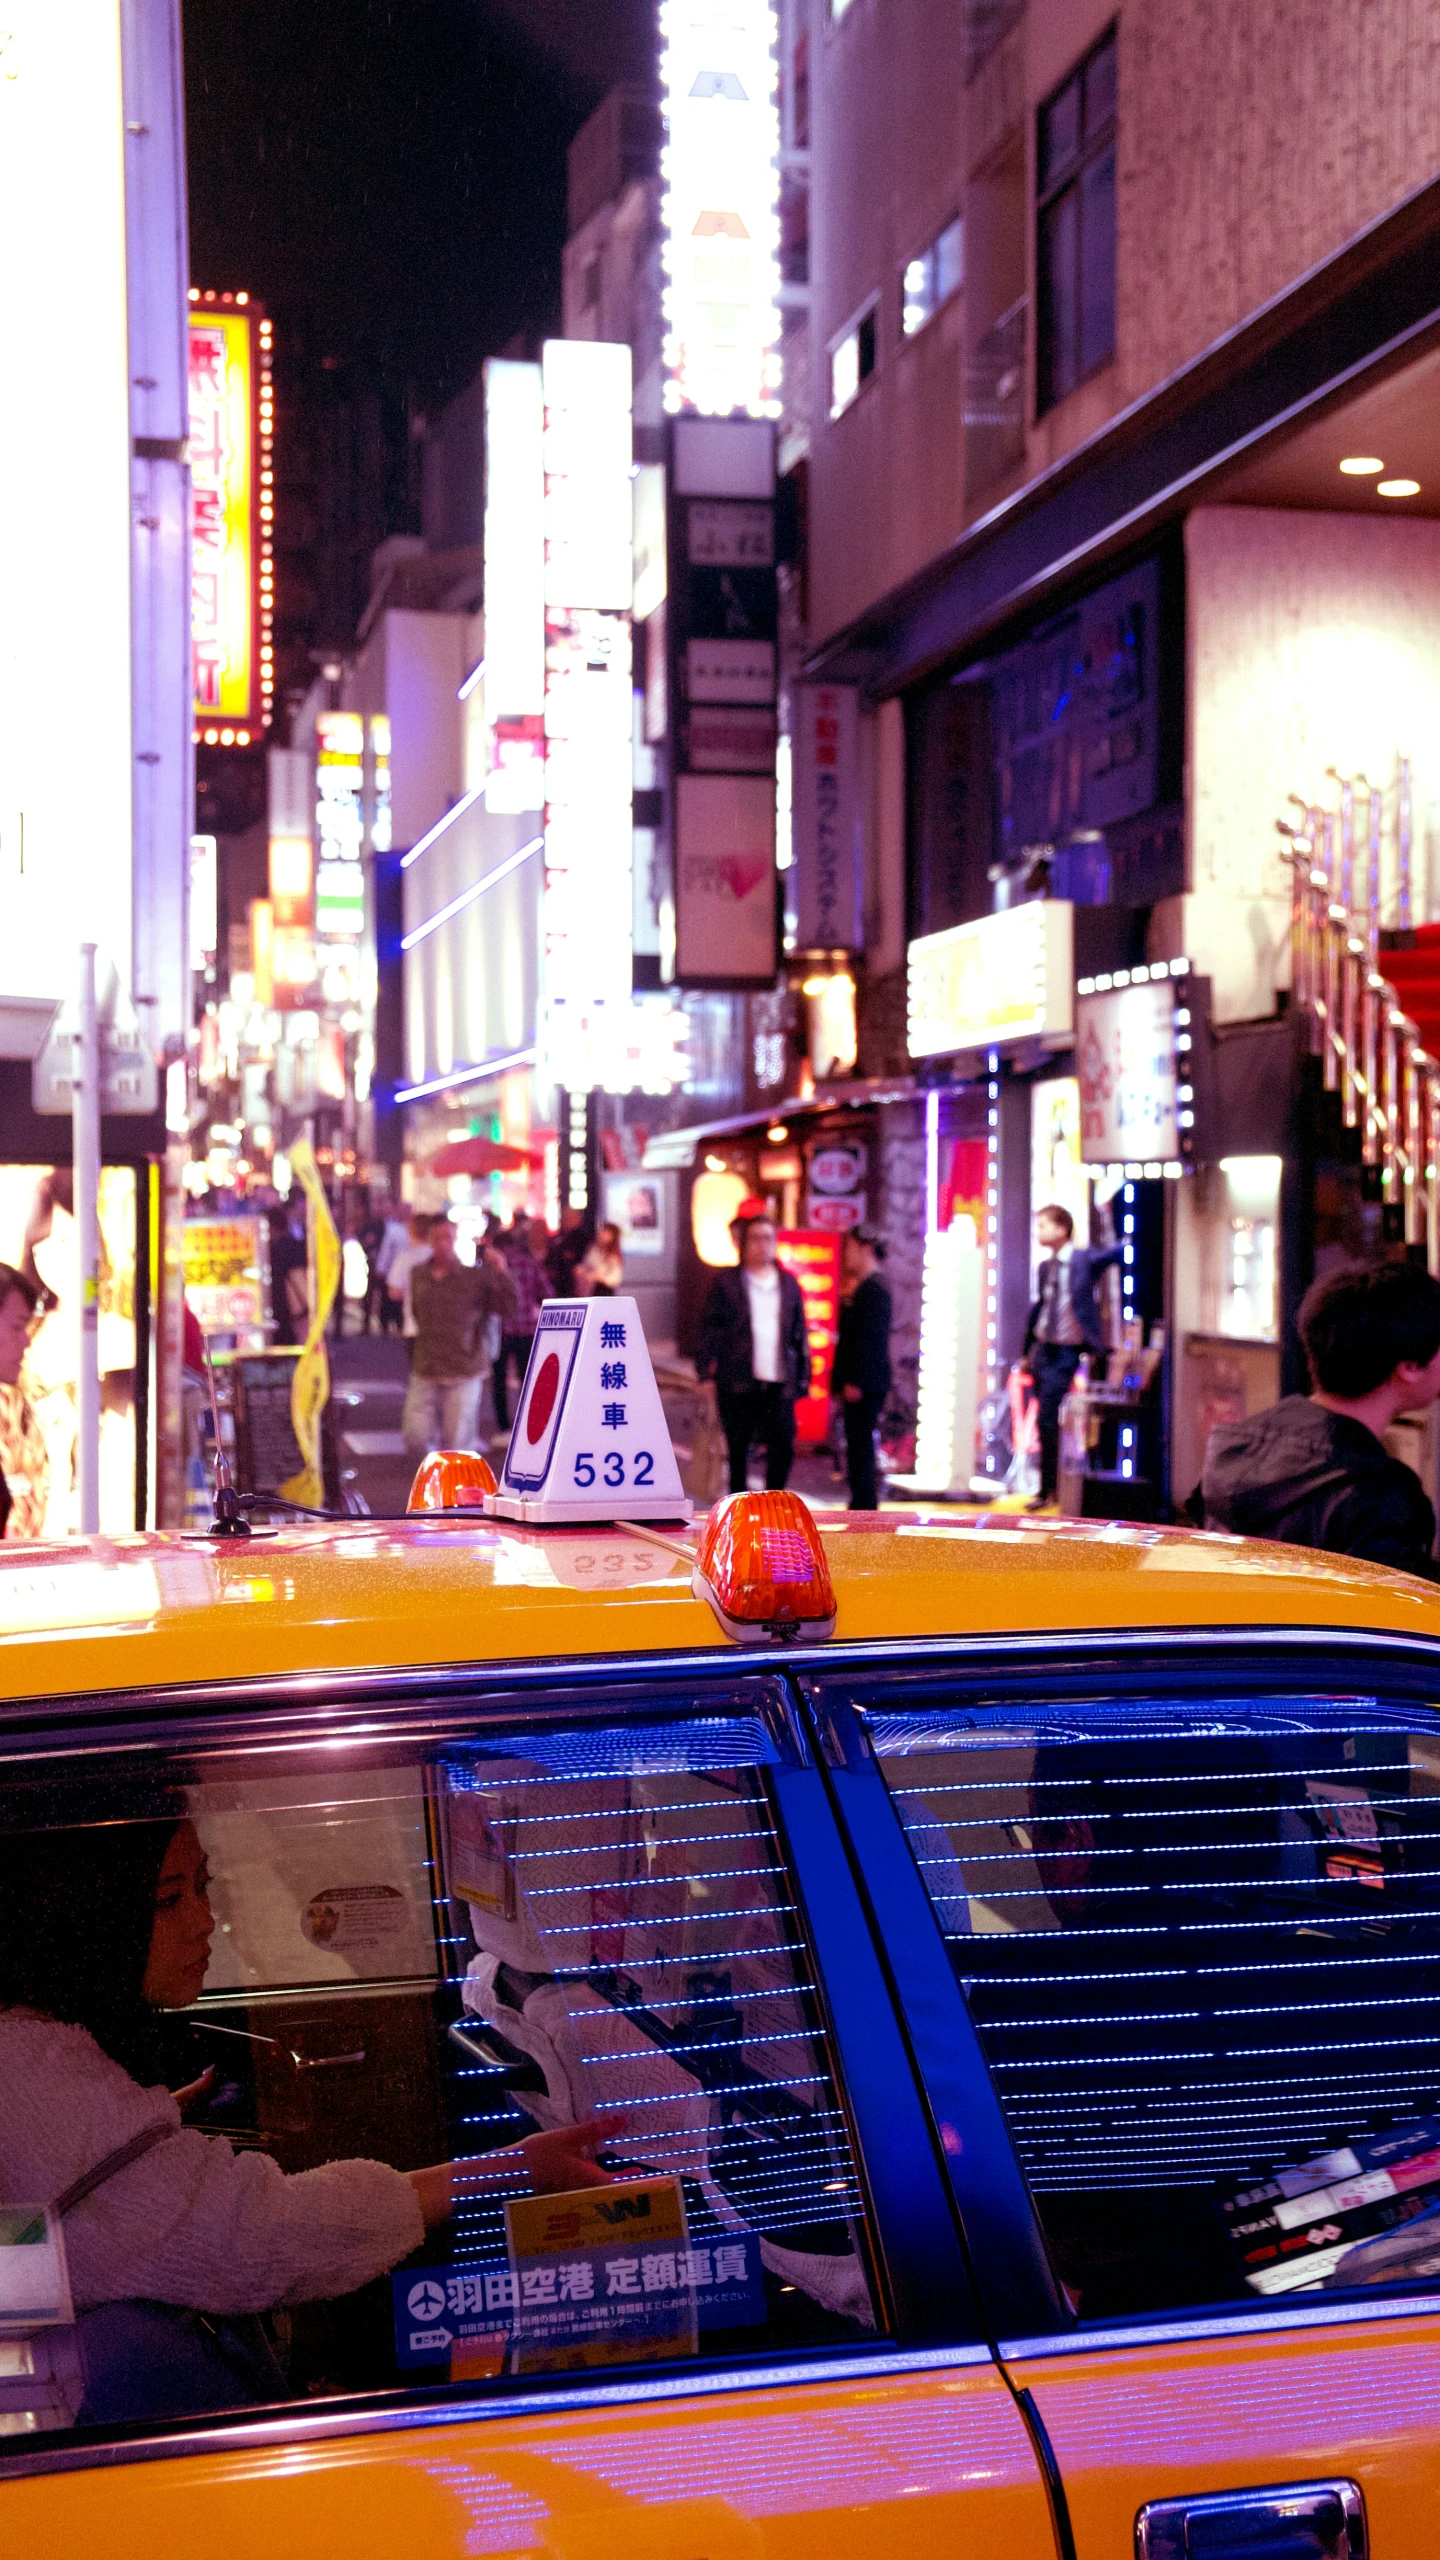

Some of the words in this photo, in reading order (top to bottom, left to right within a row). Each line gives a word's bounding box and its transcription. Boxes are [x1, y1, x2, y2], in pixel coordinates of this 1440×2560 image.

[541, 1310, 583, 1328] HINOMARU
[600, 1321, 628, 1430] 無線車
[573, 1451, 655, 1488] 532
[446, 2262, 595, 2316] 羽田空港
[605, 2243, 749, 2296] 定額運賃
